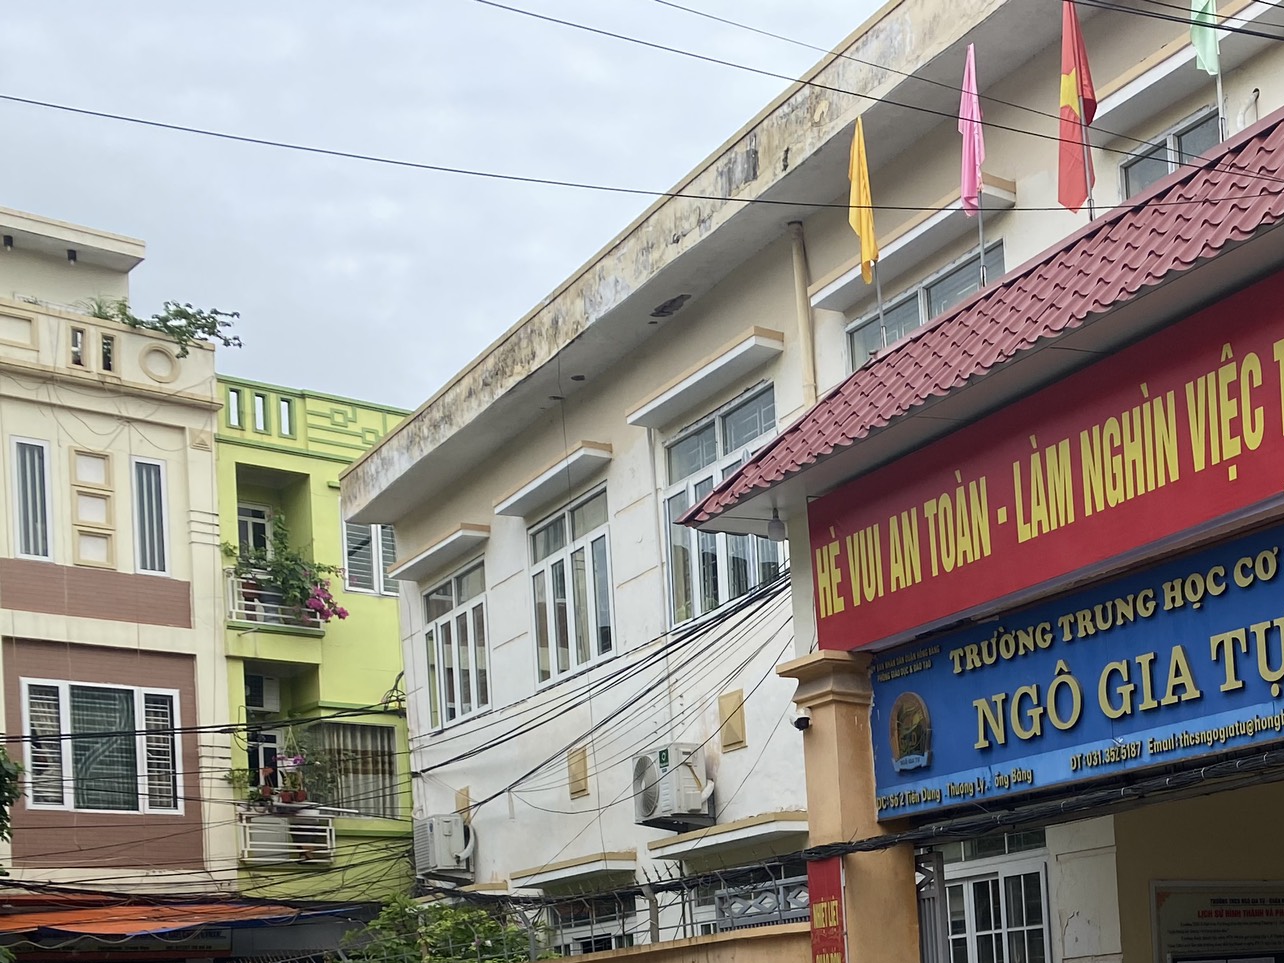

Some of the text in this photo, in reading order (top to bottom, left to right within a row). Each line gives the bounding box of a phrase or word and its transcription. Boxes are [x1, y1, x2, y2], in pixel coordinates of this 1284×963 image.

[816, 526, 845, 618] HÈ
[848, 523, 884, 608] VUI
[889, 502, 922, 593] AN
[925, 469, 991, 577] TOÀN
[1013, 434, 1075, 544] LÀM
[1079, 382, 1180, 517] NGHÌN
[1186, 342, 1265, 482] VIỆC
[949, 622, 1053, 674] TRƯỜNG
[1058, 588, 1156, 642] TRUNG
[1162, 566, 1226, 610] HỌC
[1233, 546, 1279, 588] CƠ
[973, 660, 1082, 749] NGÔ
[1098, 645, 1201, 719] GIA
